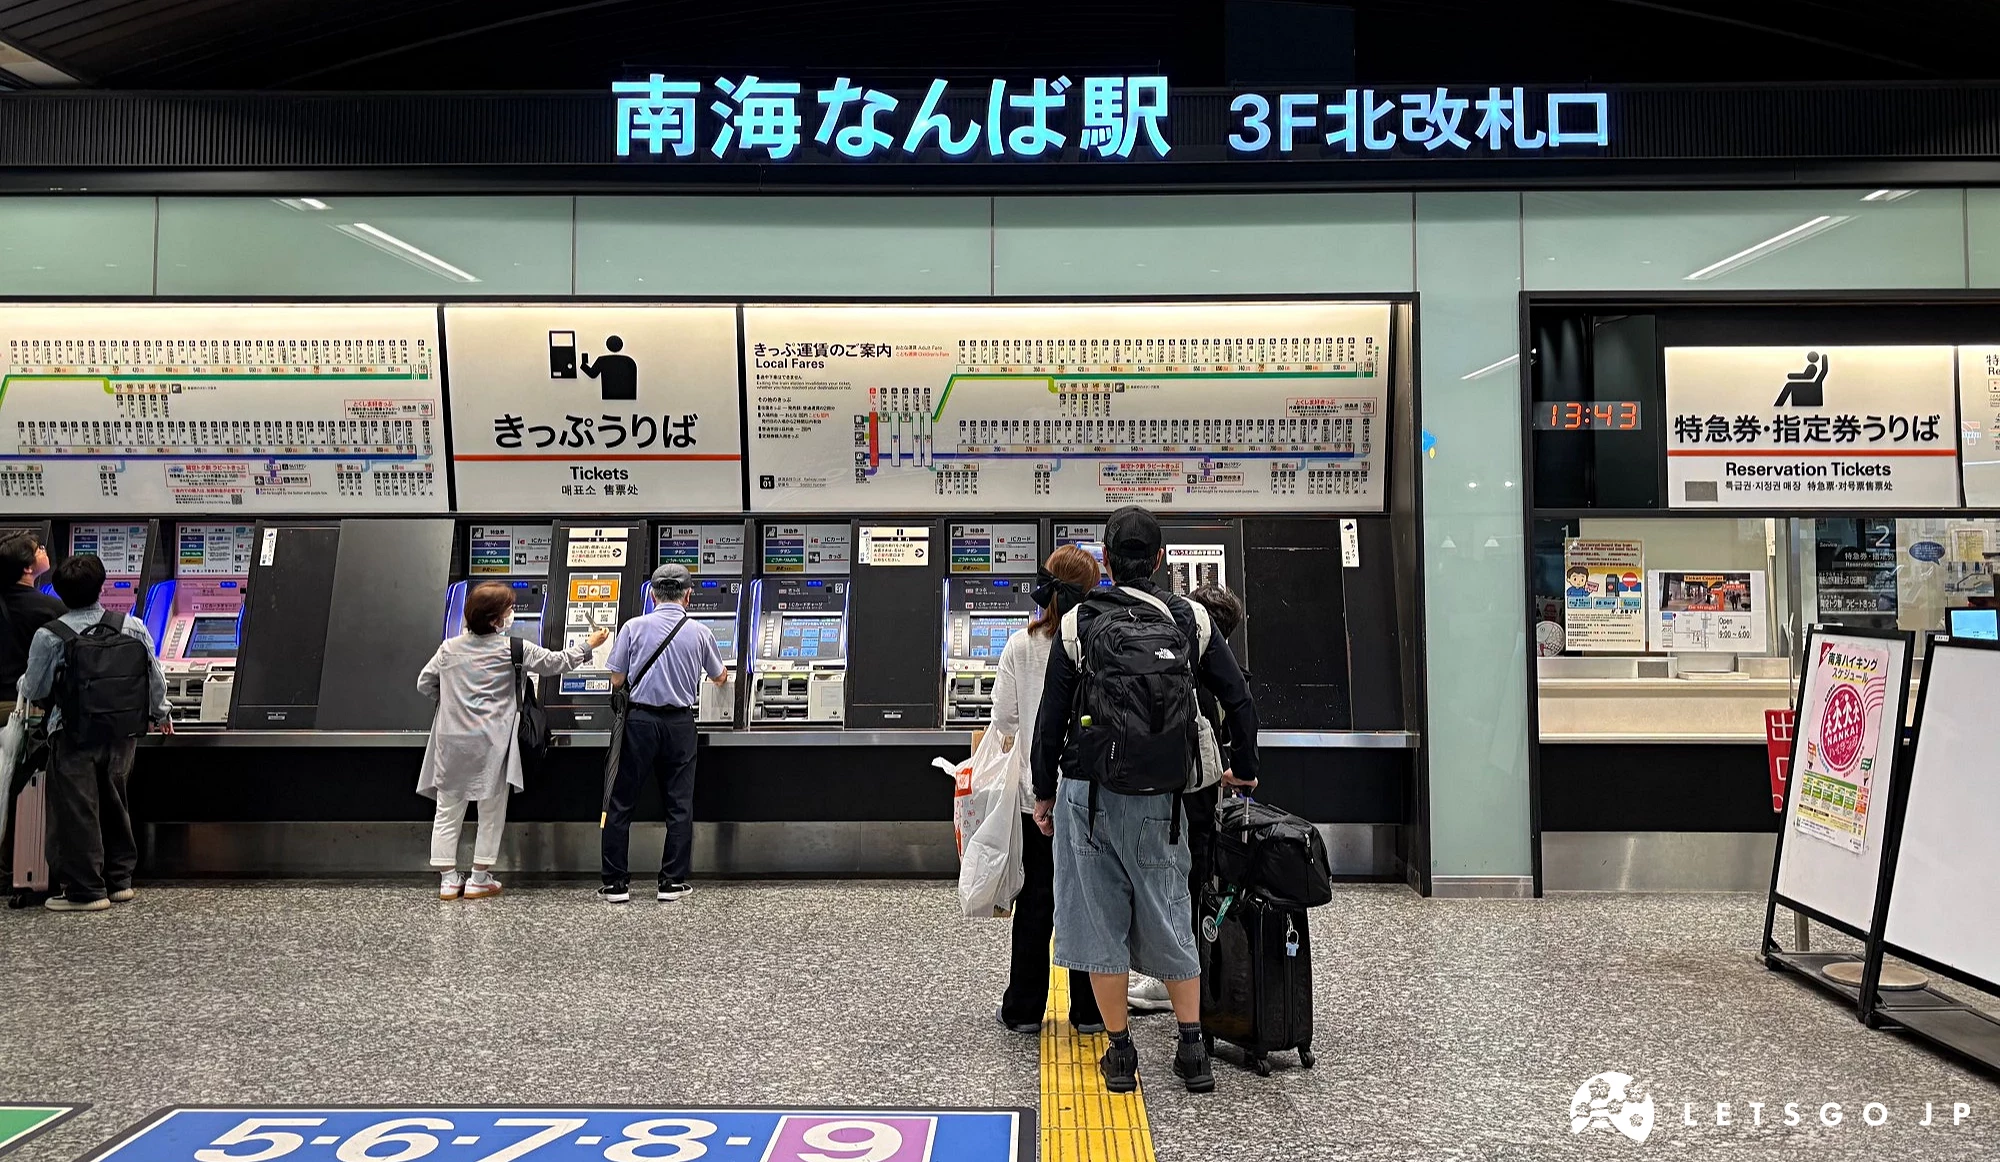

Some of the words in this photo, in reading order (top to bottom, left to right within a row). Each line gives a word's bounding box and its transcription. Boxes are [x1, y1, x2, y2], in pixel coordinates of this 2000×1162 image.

[612, 73, 1171, 159] 南海なんば駅
[1228, 86, 1609, 153] 3F北改札口
[754, 343, 891, 358] きっぷ運賃のご案内
[755, 358, 788, 369] Local
[792, 358, 825, 369] Fares
[1550, 402, 1638, 429] 13:43
[494, 412, 699, 449] きっぷうりば
[1674, 413, 1941, 444] 特急券・指定券うりば
[570, 466, 629, 481] Tickets
[1726, 461, 1827, 477] Reservation
[1831, 461, 1892, 477] Tickets
[561, 484, 597, 497] 매표소
[603, 484, 639, 496] 售票处
[762, 480, 772, 488] 01
[1783, 480, 1801, 491] 매장
[1875, 525, 1891, 547] 2
[1718, 617, 1732, 626] Open
[1720, 630, 1731, 639] 9:00
[1738, 630, 1750, 639] 6:00
[1828, 651, 1878, 671] 南海ハイキング
[1831, 667, 1869, 684] スケジュール
